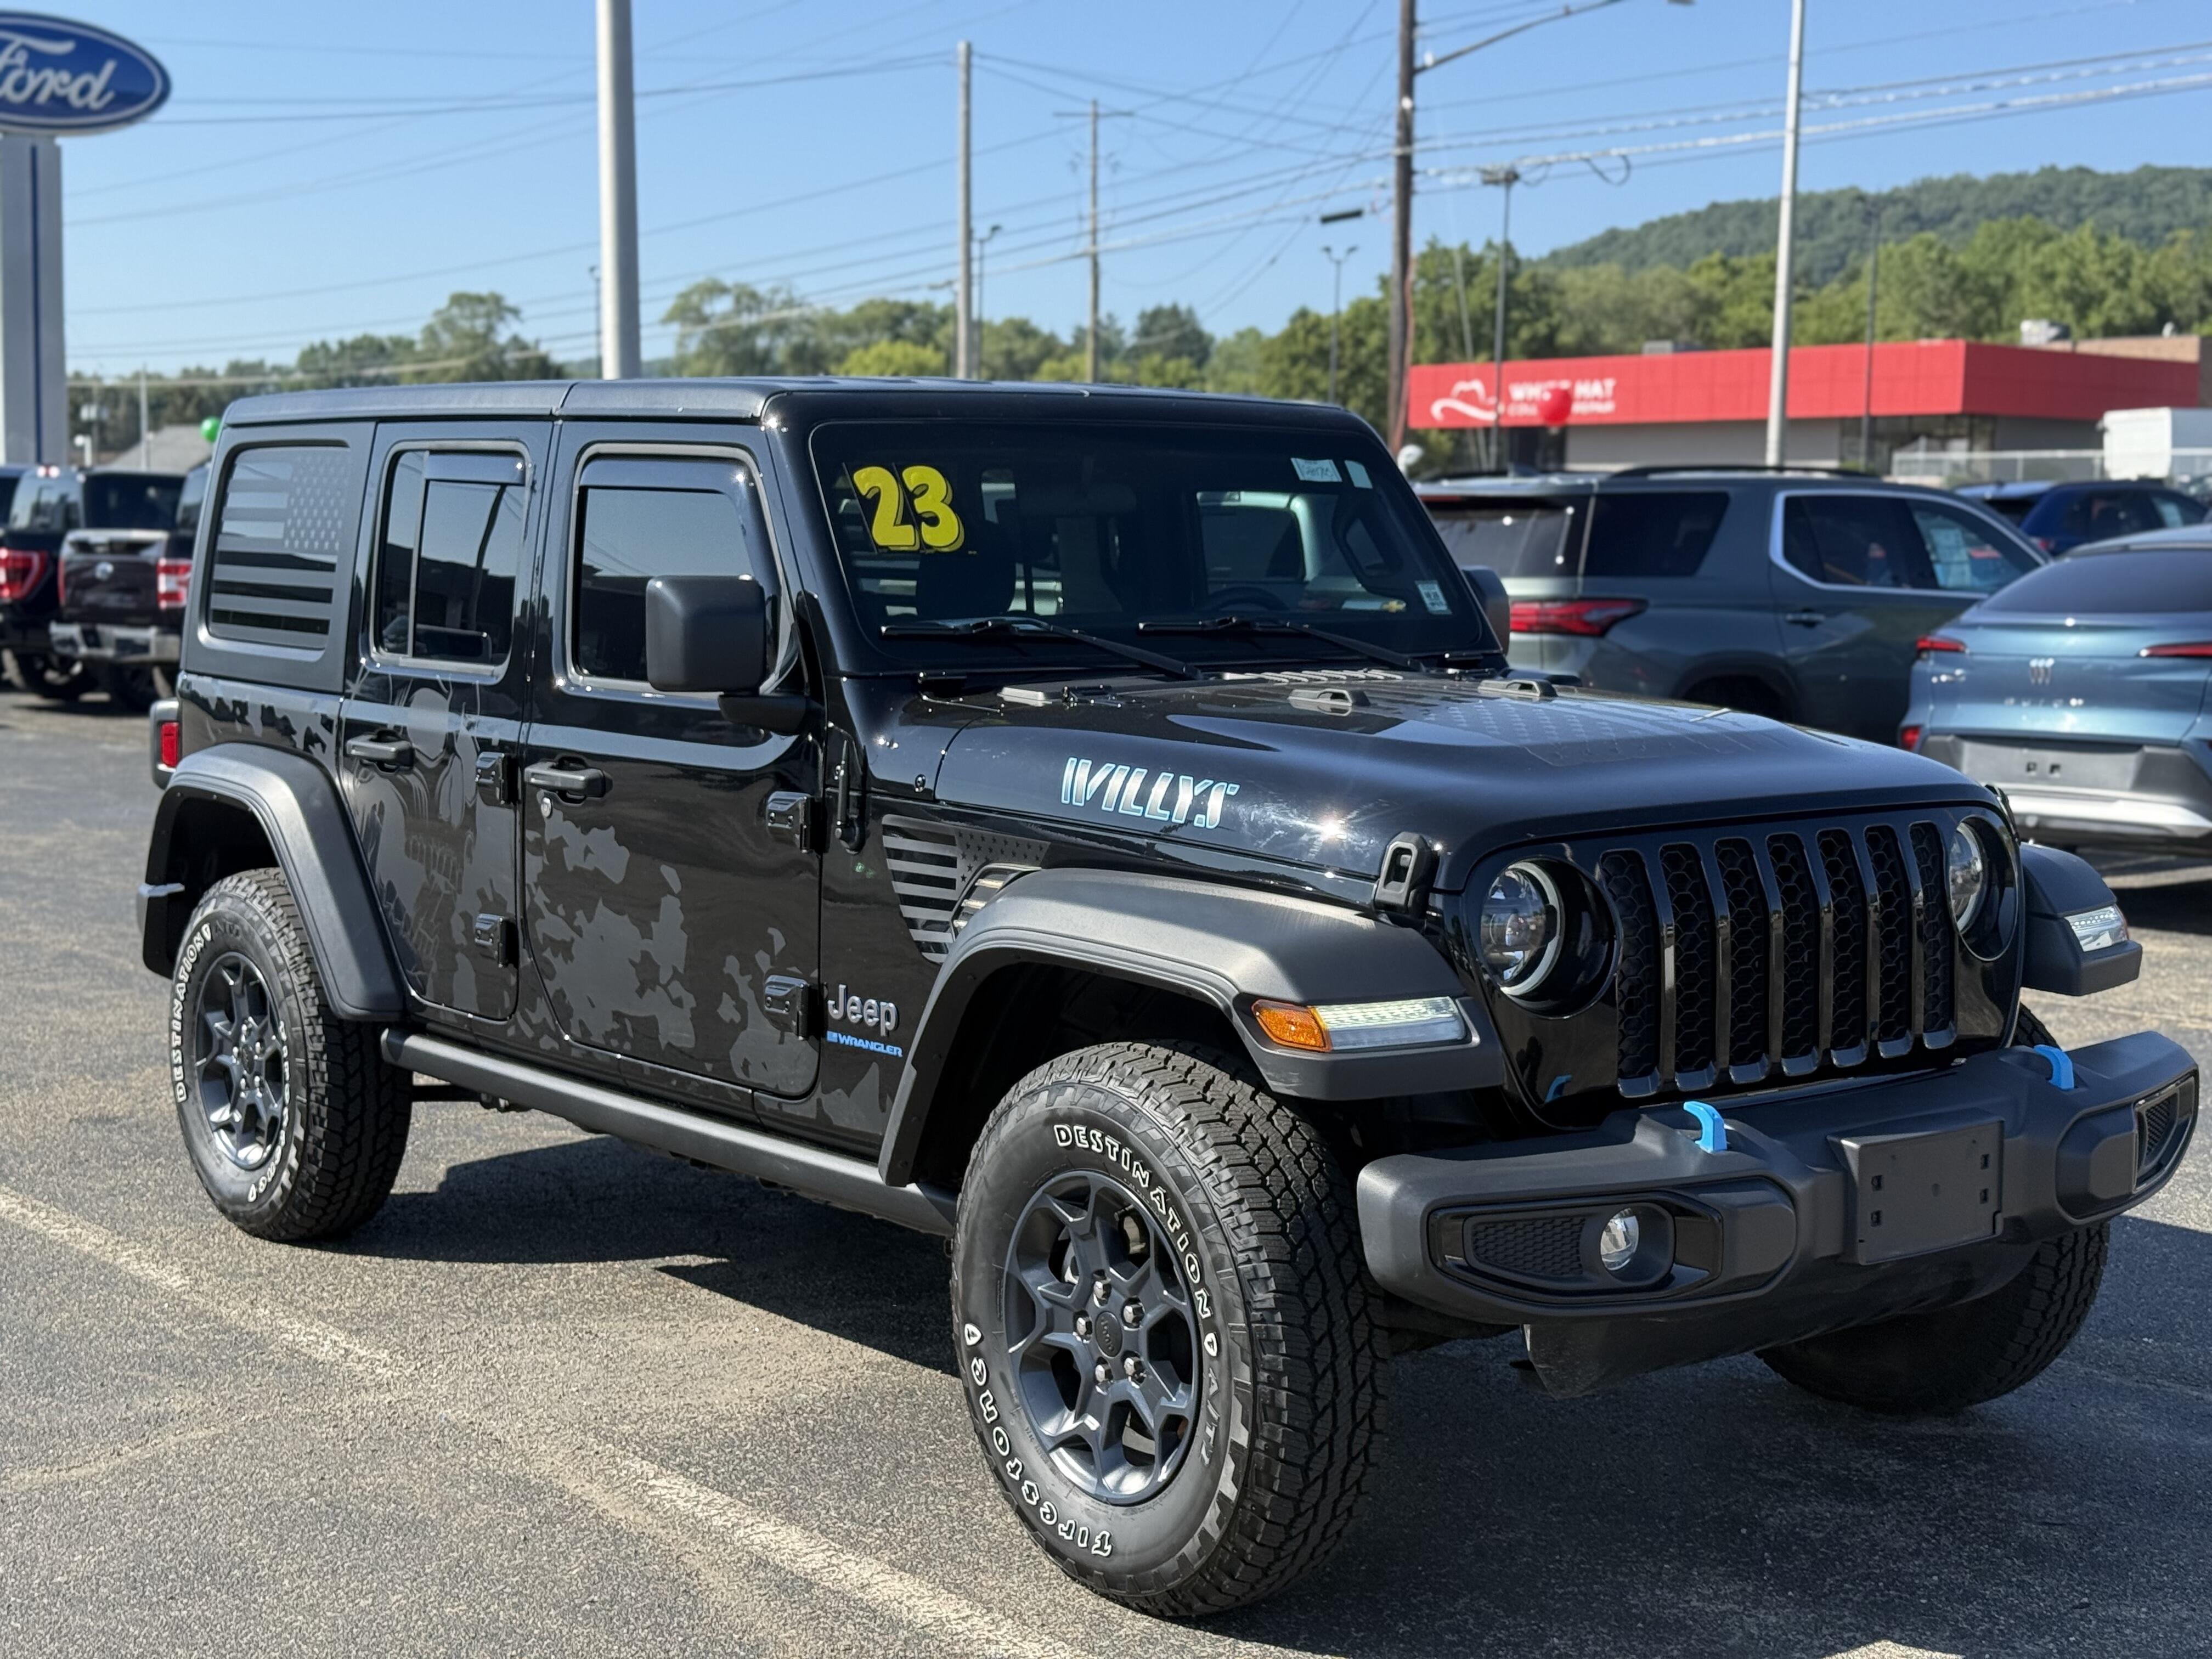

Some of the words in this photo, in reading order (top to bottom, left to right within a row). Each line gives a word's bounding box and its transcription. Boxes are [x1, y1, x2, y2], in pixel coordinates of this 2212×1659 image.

[0, 30, 117, 111] Ford
[853, 465, 964, 552] 23
[1060, 757, 1240, 830] WILLYS
[172, 934, 205, 1103] DESTINATION
[827, 984, 899, 1036] Jeep
[837, 1033, 903, 1058] WRANGLER
[1053, 1124, 1212, 1319] DESTINATION
